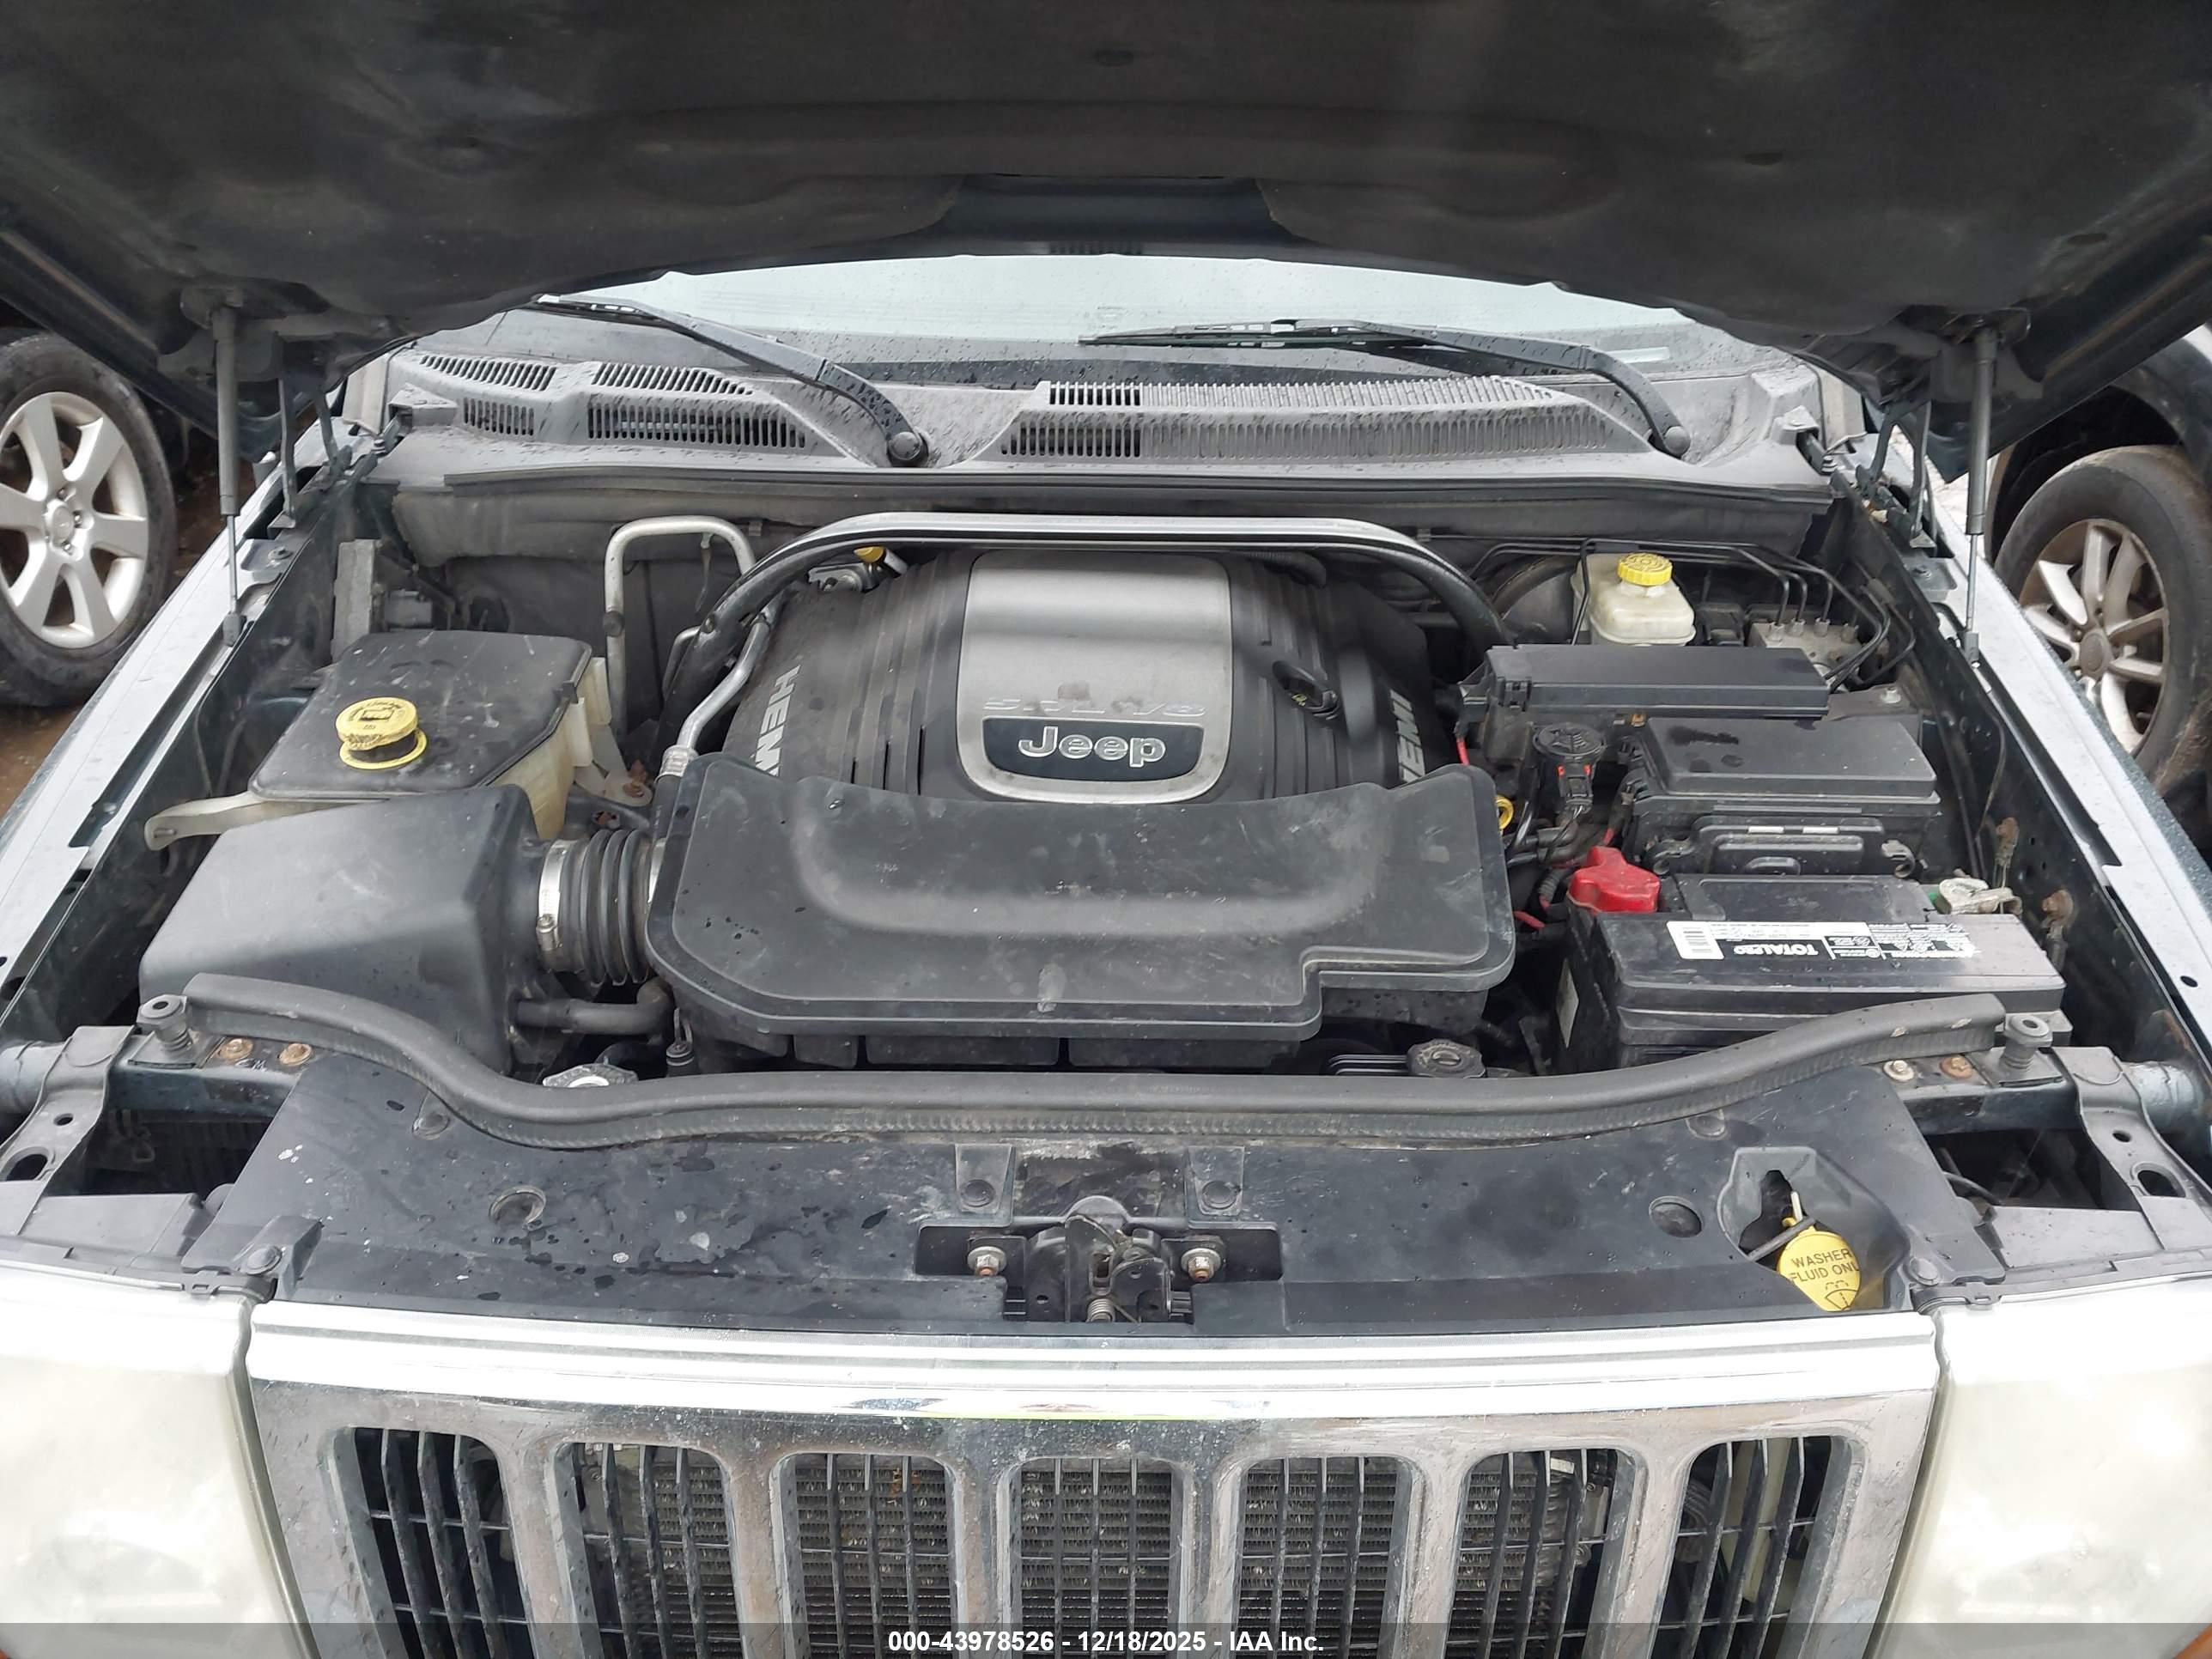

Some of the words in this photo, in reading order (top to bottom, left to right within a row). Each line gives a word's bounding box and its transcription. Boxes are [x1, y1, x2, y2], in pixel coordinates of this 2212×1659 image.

[1018, 726, 1166, 768] Jeep
[1791, 1249, 1853, 1267] WASHER
[1832, 1261, 1859, 1275] ONL
